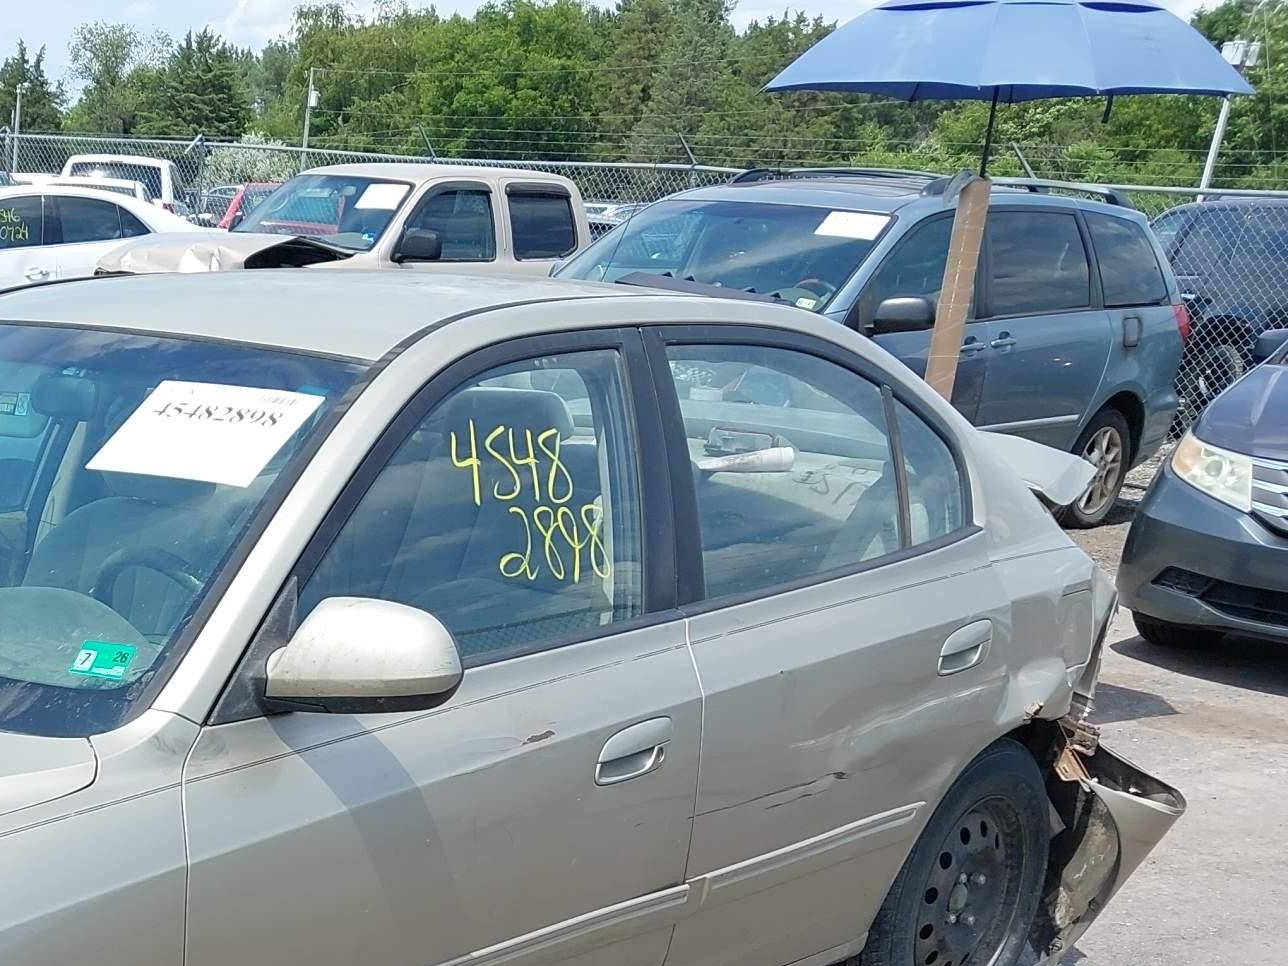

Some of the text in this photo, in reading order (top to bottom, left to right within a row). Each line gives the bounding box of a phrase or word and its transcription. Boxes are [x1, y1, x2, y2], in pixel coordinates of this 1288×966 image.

[0, 221, 29, 242] 0724
[154, 402, 284, 427] 45482898
[450, 417, 574, 506] 4548
[499, 504, 611, 583] 2898
[80, 651, 130, 666] 7 26
